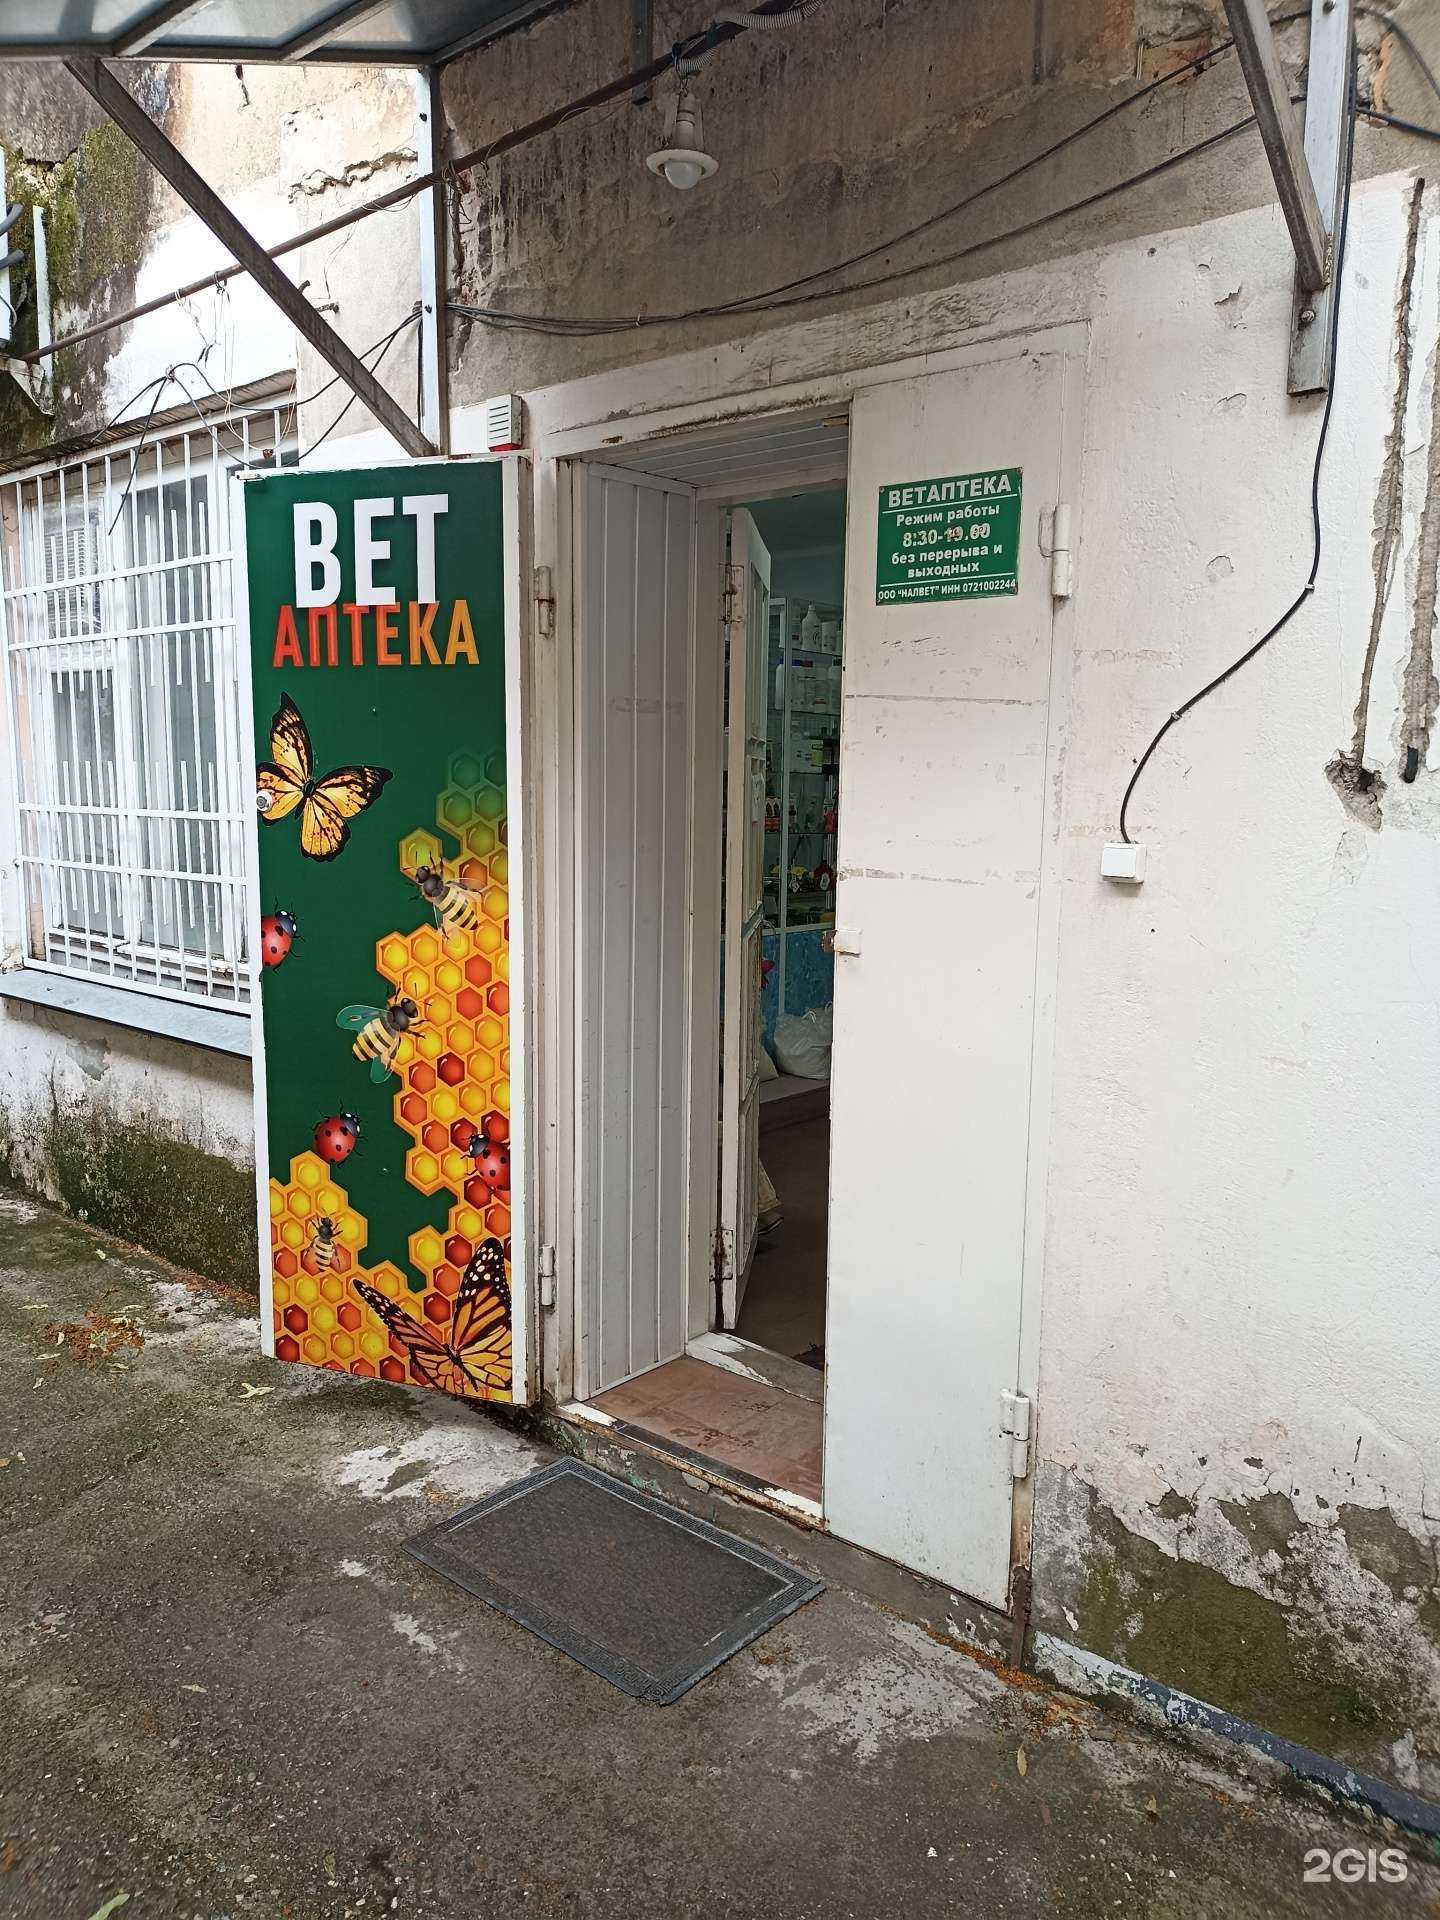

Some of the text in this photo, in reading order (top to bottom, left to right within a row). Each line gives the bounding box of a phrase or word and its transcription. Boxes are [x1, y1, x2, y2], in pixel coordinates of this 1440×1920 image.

[888, 474, 1012, 508] ВЕТАПТЕКА
[896, 504, 1000, 527] Режим работы
[293, 494, 449, 608] ВЕТ
[891, 544, 1003, 565] без перерыва и
[907, 562, 980, 579] выходных
[878, 590, 896, 600] ООО
[941, 584, 961, 595] ИНН
[962, 578, 1016, 593] 0721002244
[272, 599, 480, 667] АПТЕКА
